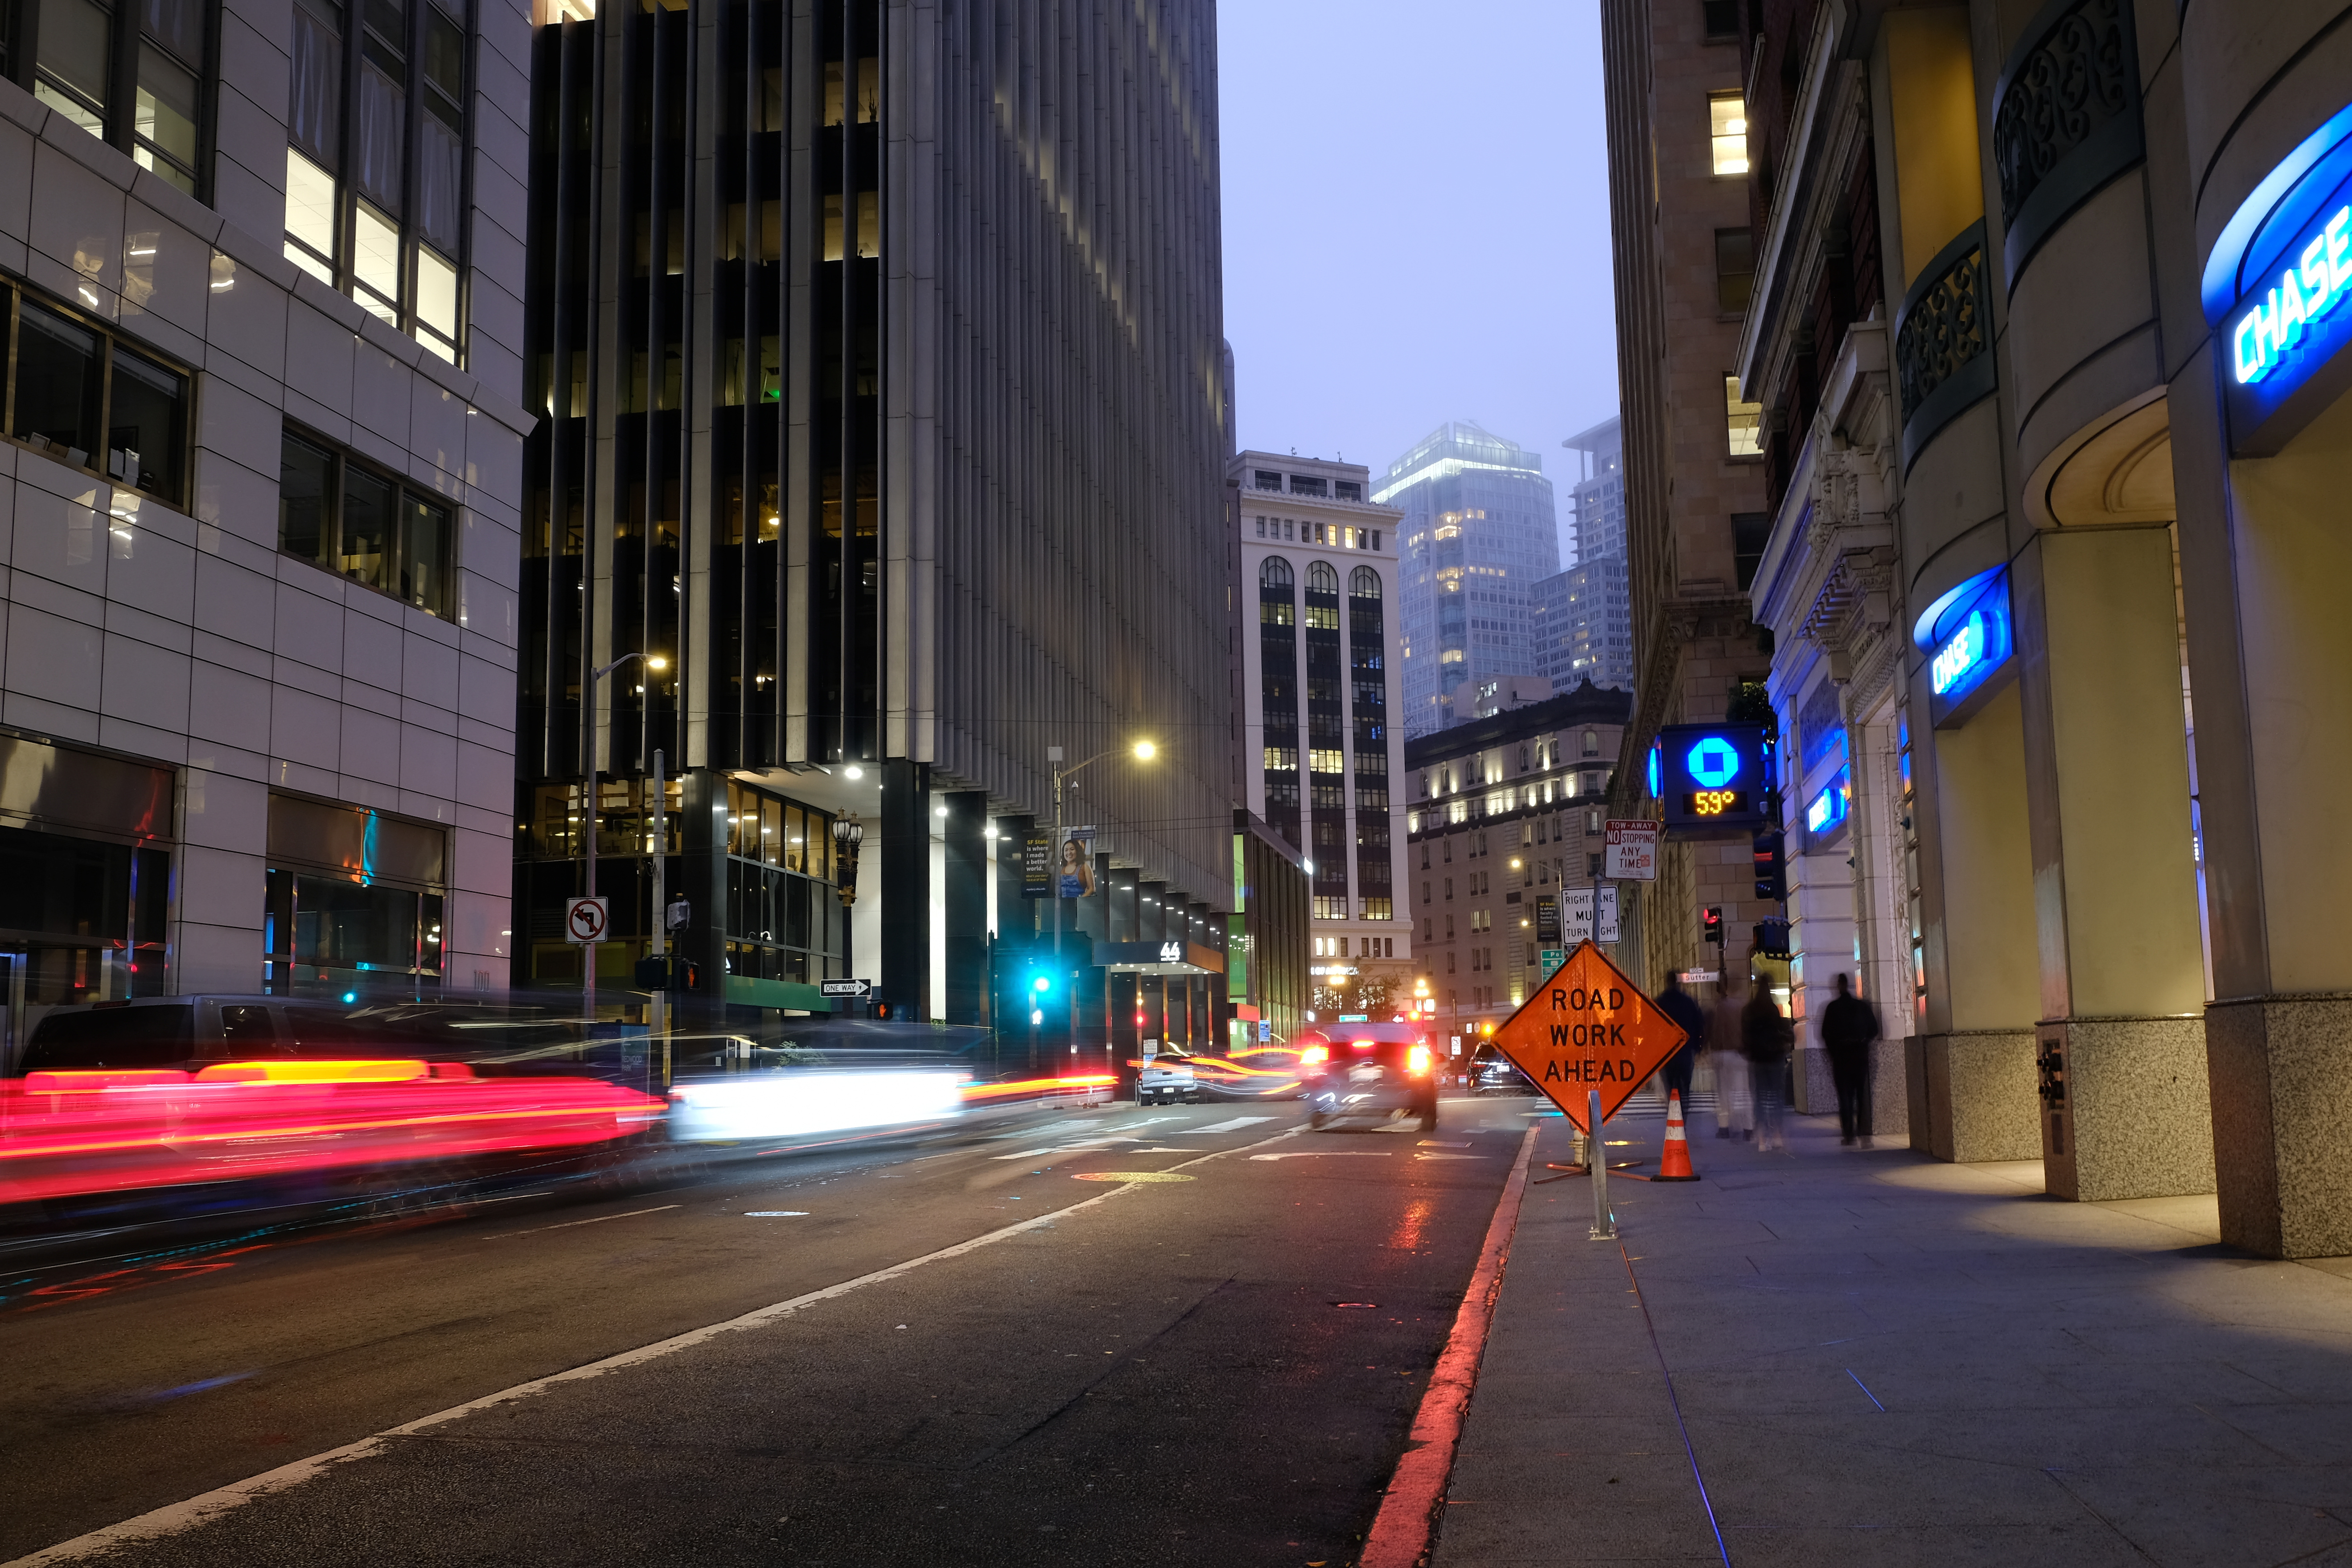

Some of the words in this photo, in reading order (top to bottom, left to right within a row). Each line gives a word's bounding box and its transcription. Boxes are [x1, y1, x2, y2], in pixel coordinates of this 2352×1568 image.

[2234, 205, 2352, 384] CHASE
[1933, 626, 1971, 695] CHASE
[1607, 830, 1620, 844] NO
[1622, 833, 1654, 844] STOPPING
[1621, 847, 1640, 856] ANY
[1619, 859, 1641, 868] TIME
[1565, 895, 1589, 905] RIGHT
[1592, 894, 1614, 903] LNE
[1576, 910, 1605, 922] MUT
[1567, 928, 1588, 937] TURN
[1160, 942, 1180, 959] 44
[1552, 988, 1624, 1011] ROAD
[1550, 1024, 1626, 1046] WORK
[1544, 1060, 1635, 1082] AHEAD
